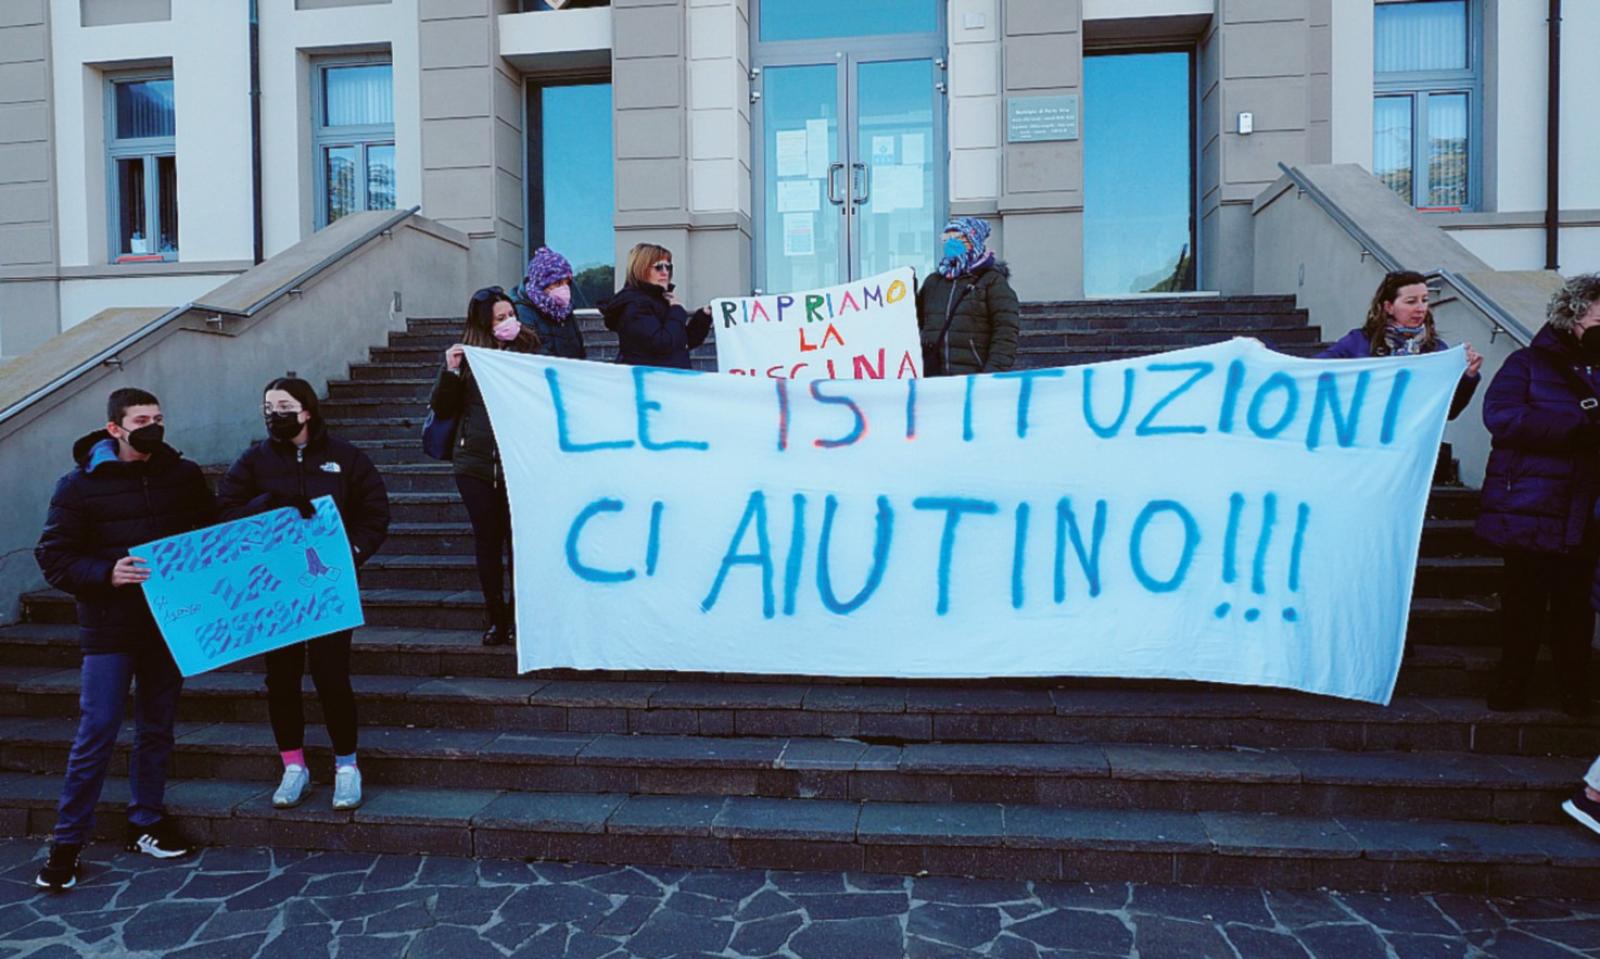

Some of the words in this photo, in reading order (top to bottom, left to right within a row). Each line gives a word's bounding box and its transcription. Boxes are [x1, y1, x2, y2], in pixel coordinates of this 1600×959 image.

[721, 280, 906, 328] RIAPRIAMO
[799, 323, 845, 352] LA
[545, 367, 709, 451] LE
[566, 497, 664, 582] CI
[700, 490, 1310, 622] AIUTINO!!!
